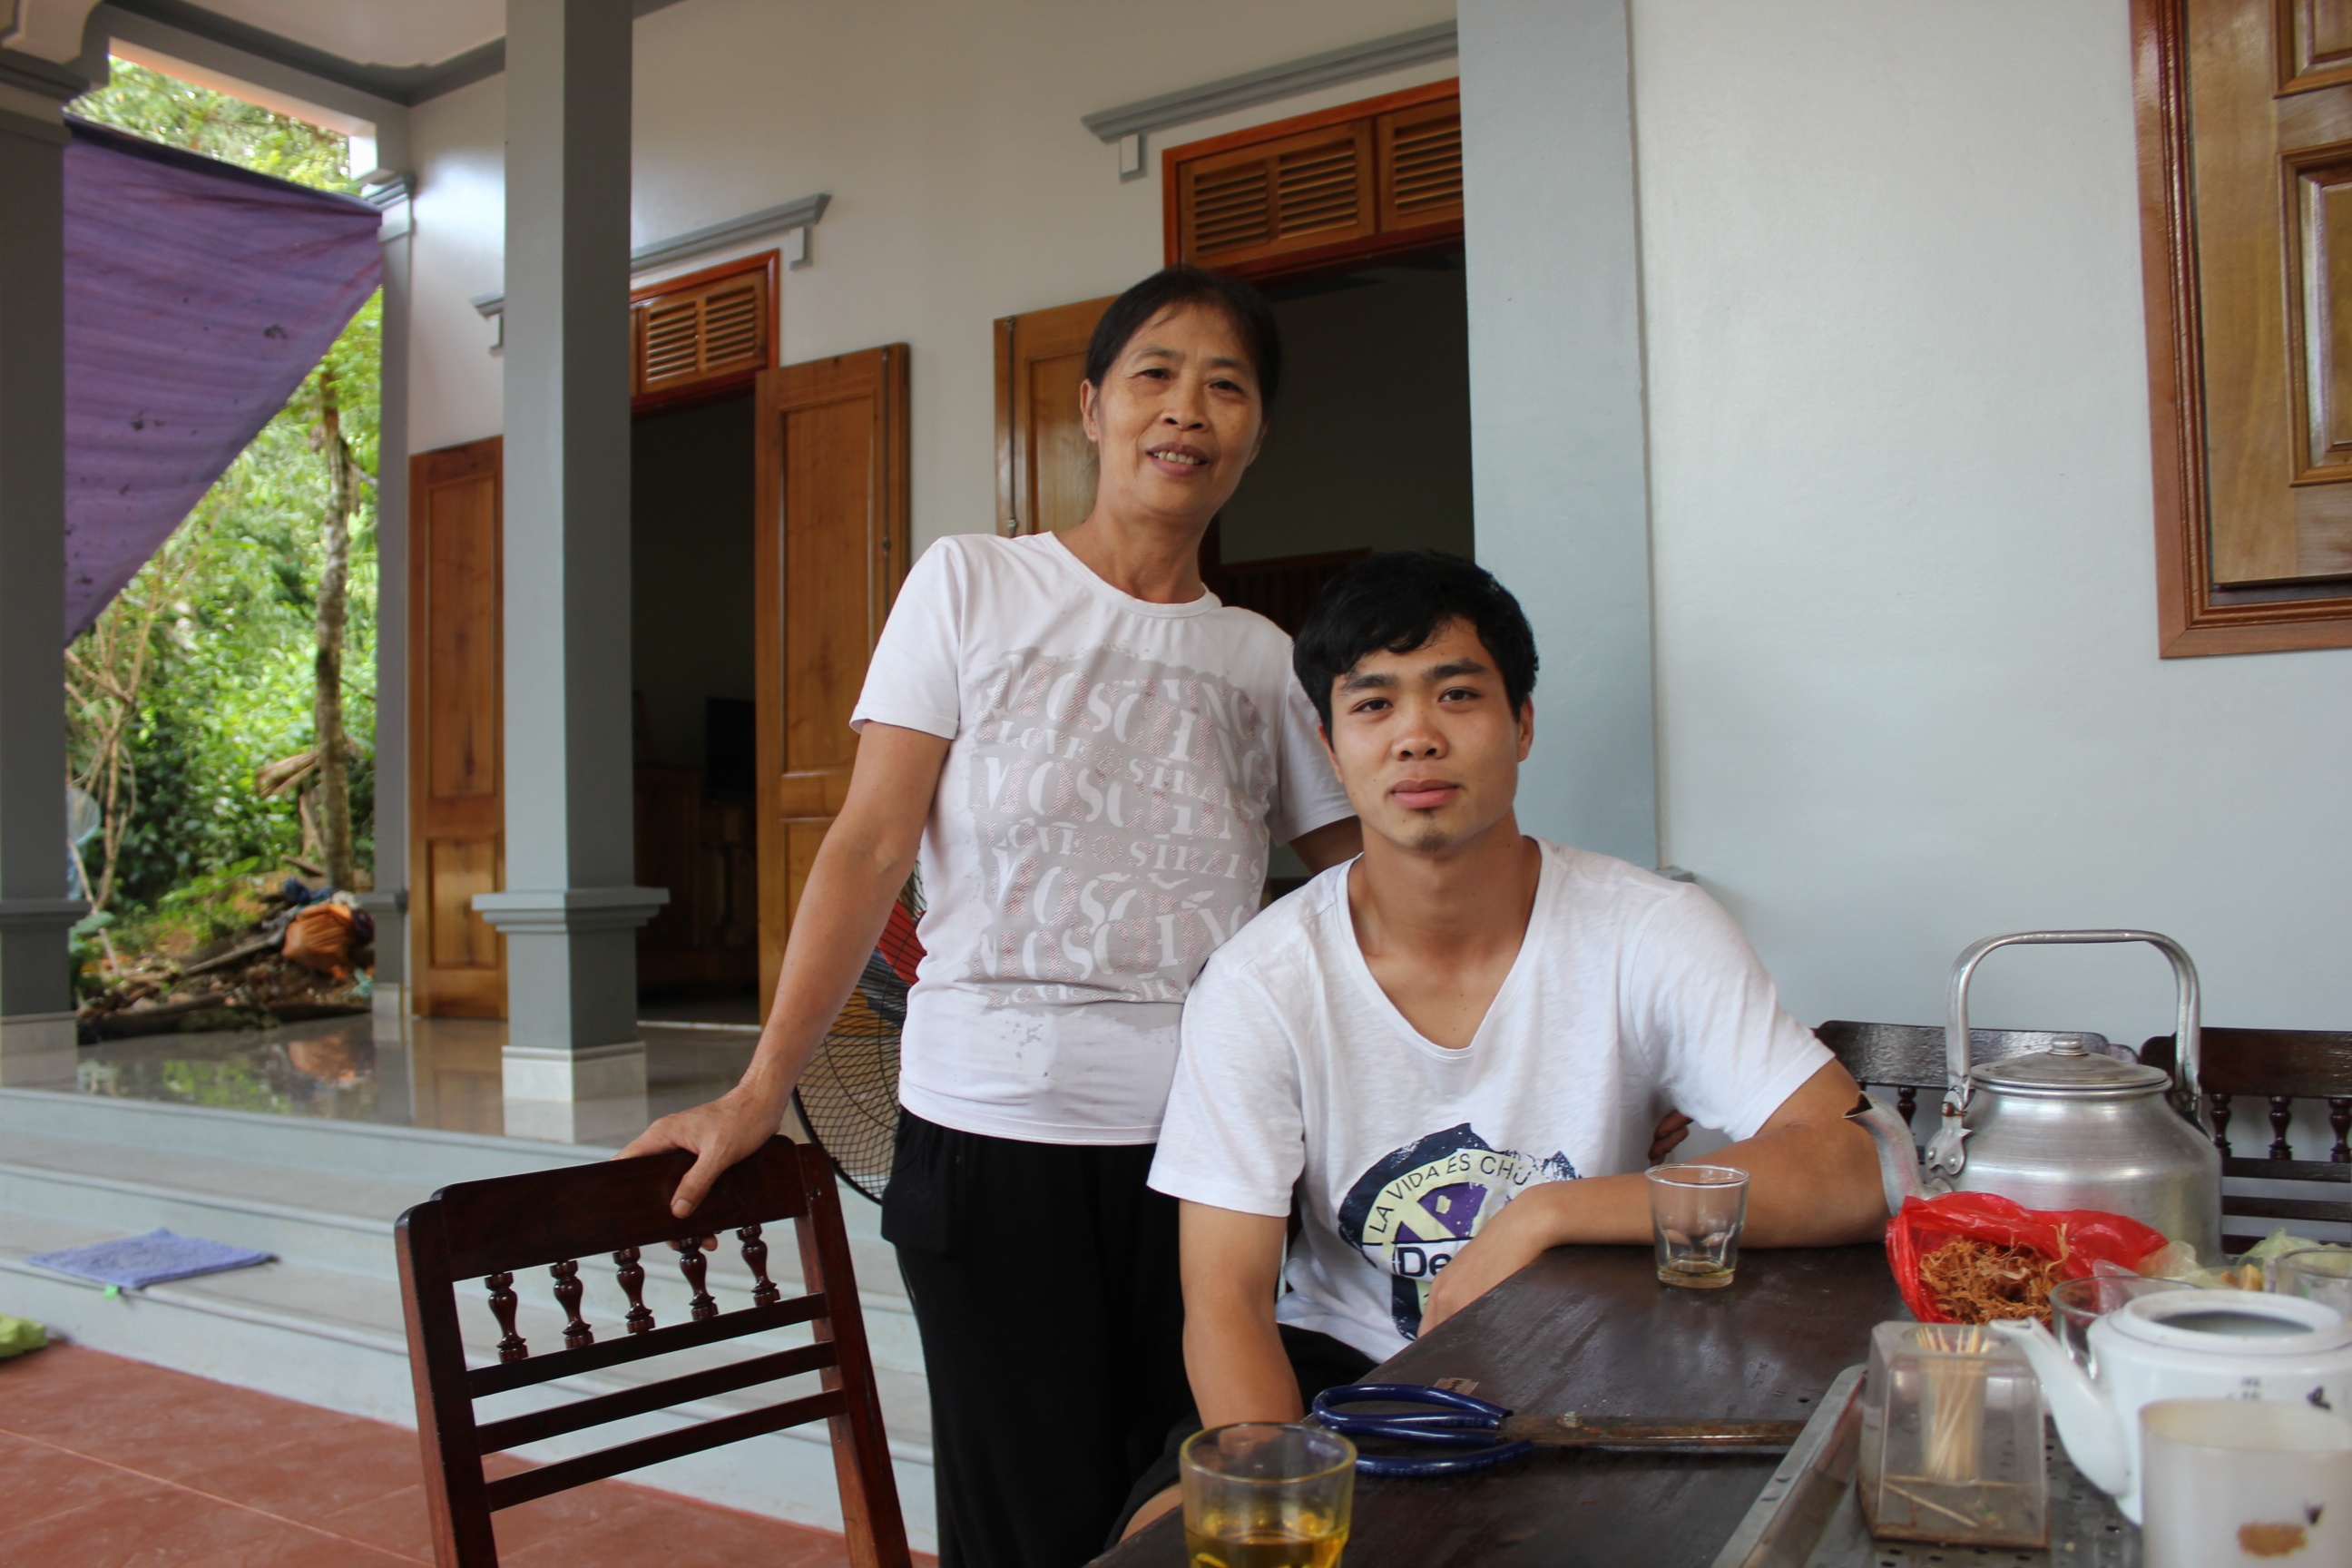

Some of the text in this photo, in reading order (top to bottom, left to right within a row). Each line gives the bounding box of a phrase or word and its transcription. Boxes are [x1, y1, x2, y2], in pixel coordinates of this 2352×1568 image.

[985, 820, 1086, 858] LOVE
[1368, 1206, 1395, 1234] LA
[1386, 1165, 1440, 1200] VIDA
[1446, 1152, 1471, 1174] ES
